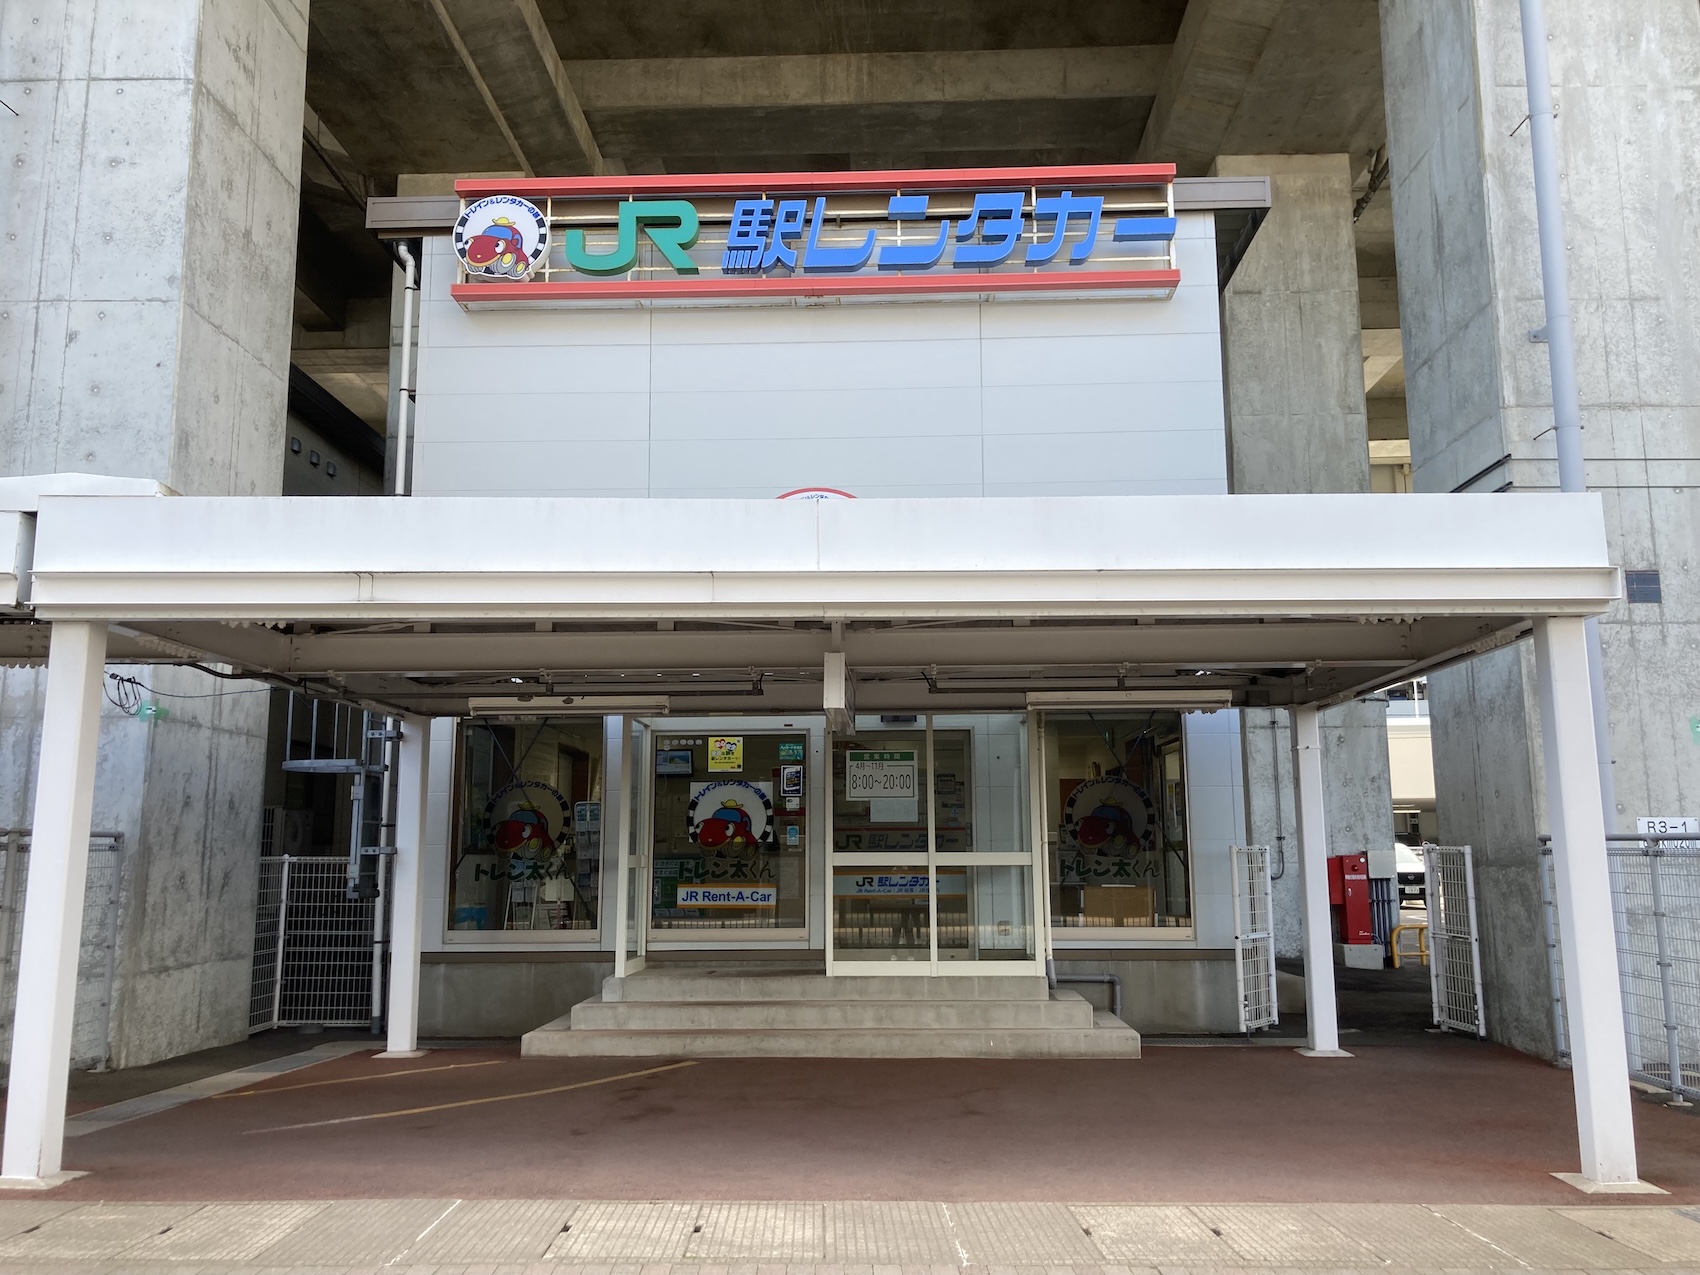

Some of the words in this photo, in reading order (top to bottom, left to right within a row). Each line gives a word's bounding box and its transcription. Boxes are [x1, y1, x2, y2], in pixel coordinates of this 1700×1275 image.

[565, 200, 699, 275] JR
[721, 191, 1177, 275] 駅レンタカー
[1646, 820, 1688, 834] R3-1
[835, 834, 863, 850] JR
[475, 862, 573, 882] トレン太くん
[678, 860, 777, 880] トレン太くん
[1060, 859, 1160, 878] トレン太くん
[856, 876, 874, 887] JR
[682, 891, 699, 902] JR
[702, 891, 772, 902] Rent-A-Car
